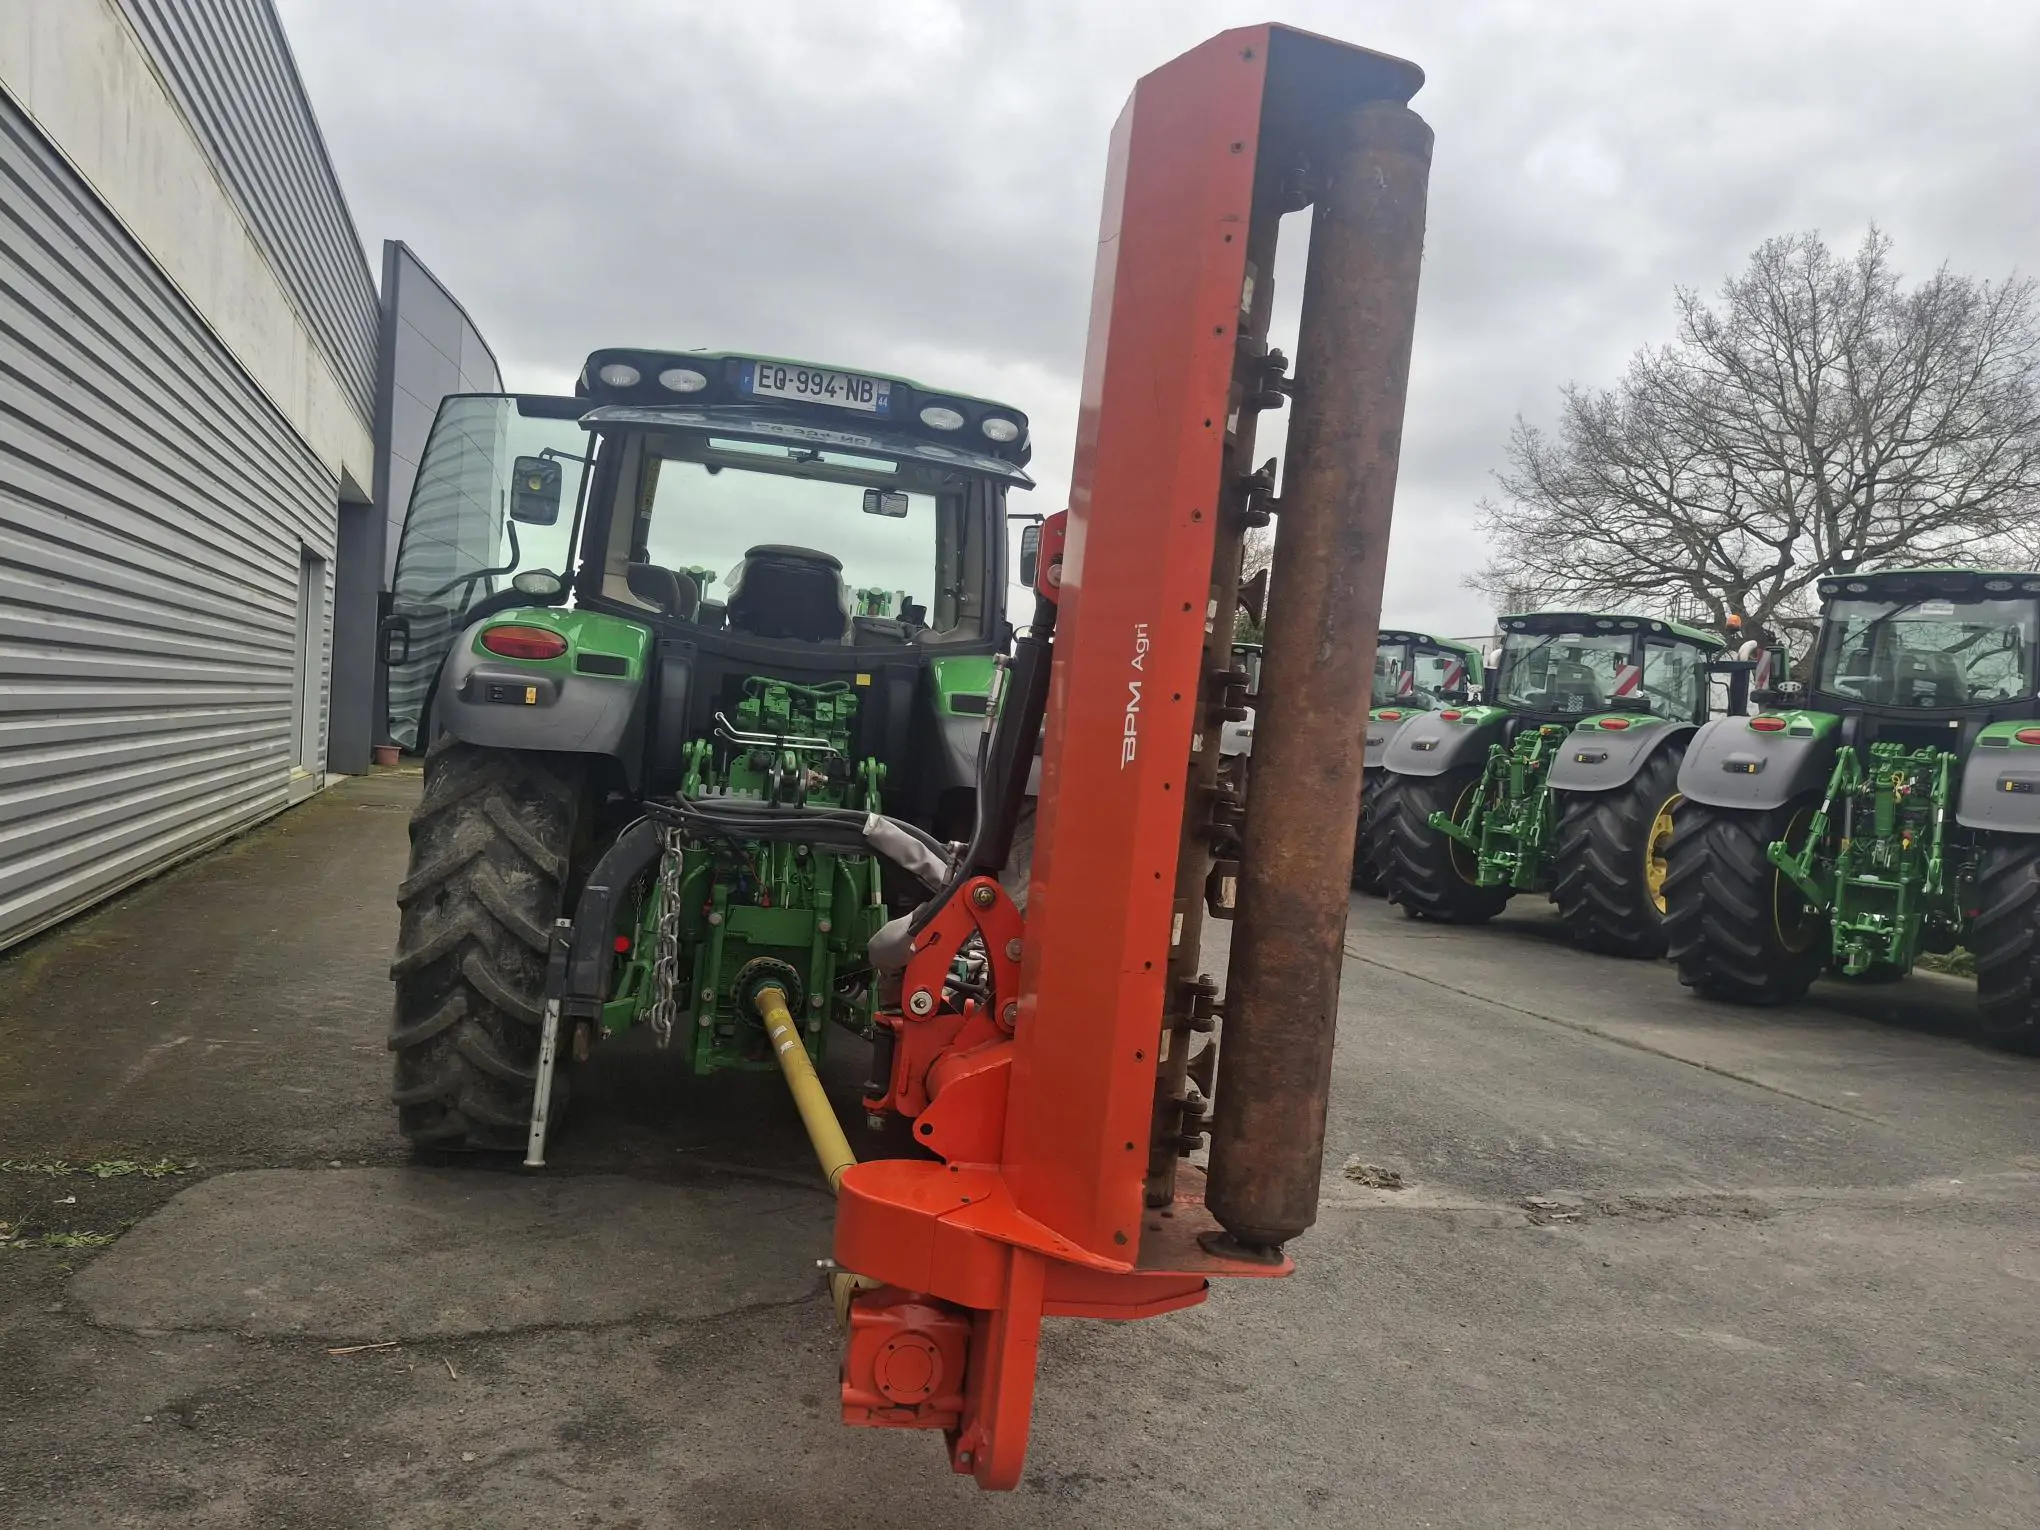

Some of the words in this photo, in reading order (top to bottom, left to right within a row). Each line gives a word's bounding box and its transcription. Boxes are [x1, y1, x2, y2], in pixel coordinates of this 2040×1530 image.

[758, 365, 873, 403] EQ-994-NB
[1120, 681, 1142, 771] BPM
[1131, 623, 1150, 672] Agri
